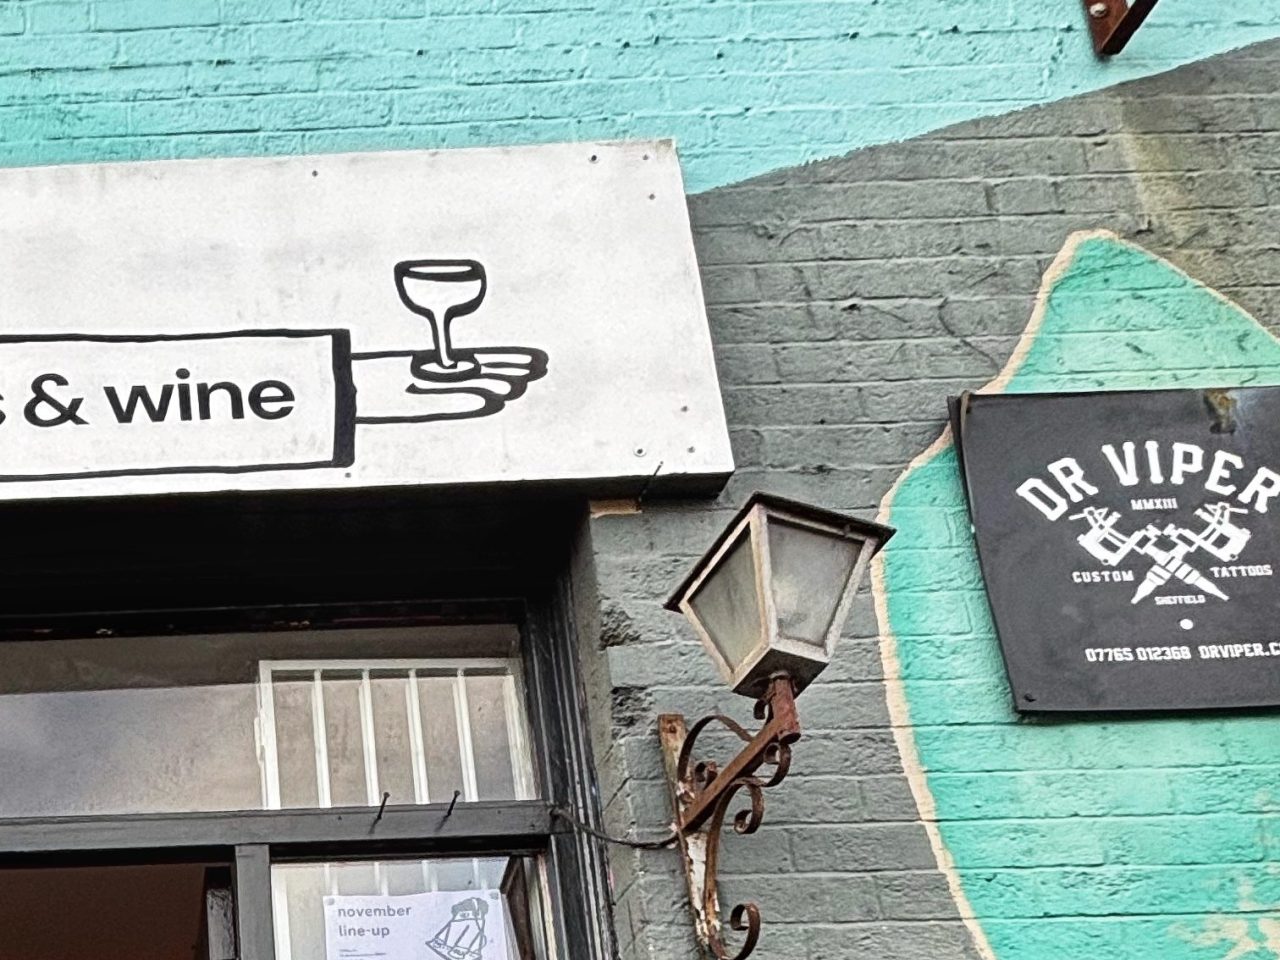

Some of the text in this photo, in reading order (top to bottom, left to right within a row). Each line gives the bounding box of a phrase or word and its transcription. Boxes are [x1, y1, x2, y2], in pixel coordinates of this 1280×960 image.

[23, 373, 89, 428] &
[103, 368, 295, 424] wine
[1016, 440, 1280, 522] DR VIPER
[1071, 564, 1273, 584] CUSTOM TATTOOS
[1084, 642, 1280, 662] 07765 012368 DRVIPER.C
[338, 905, 412, 918] november
[338, 924, 390, 939] line-up
